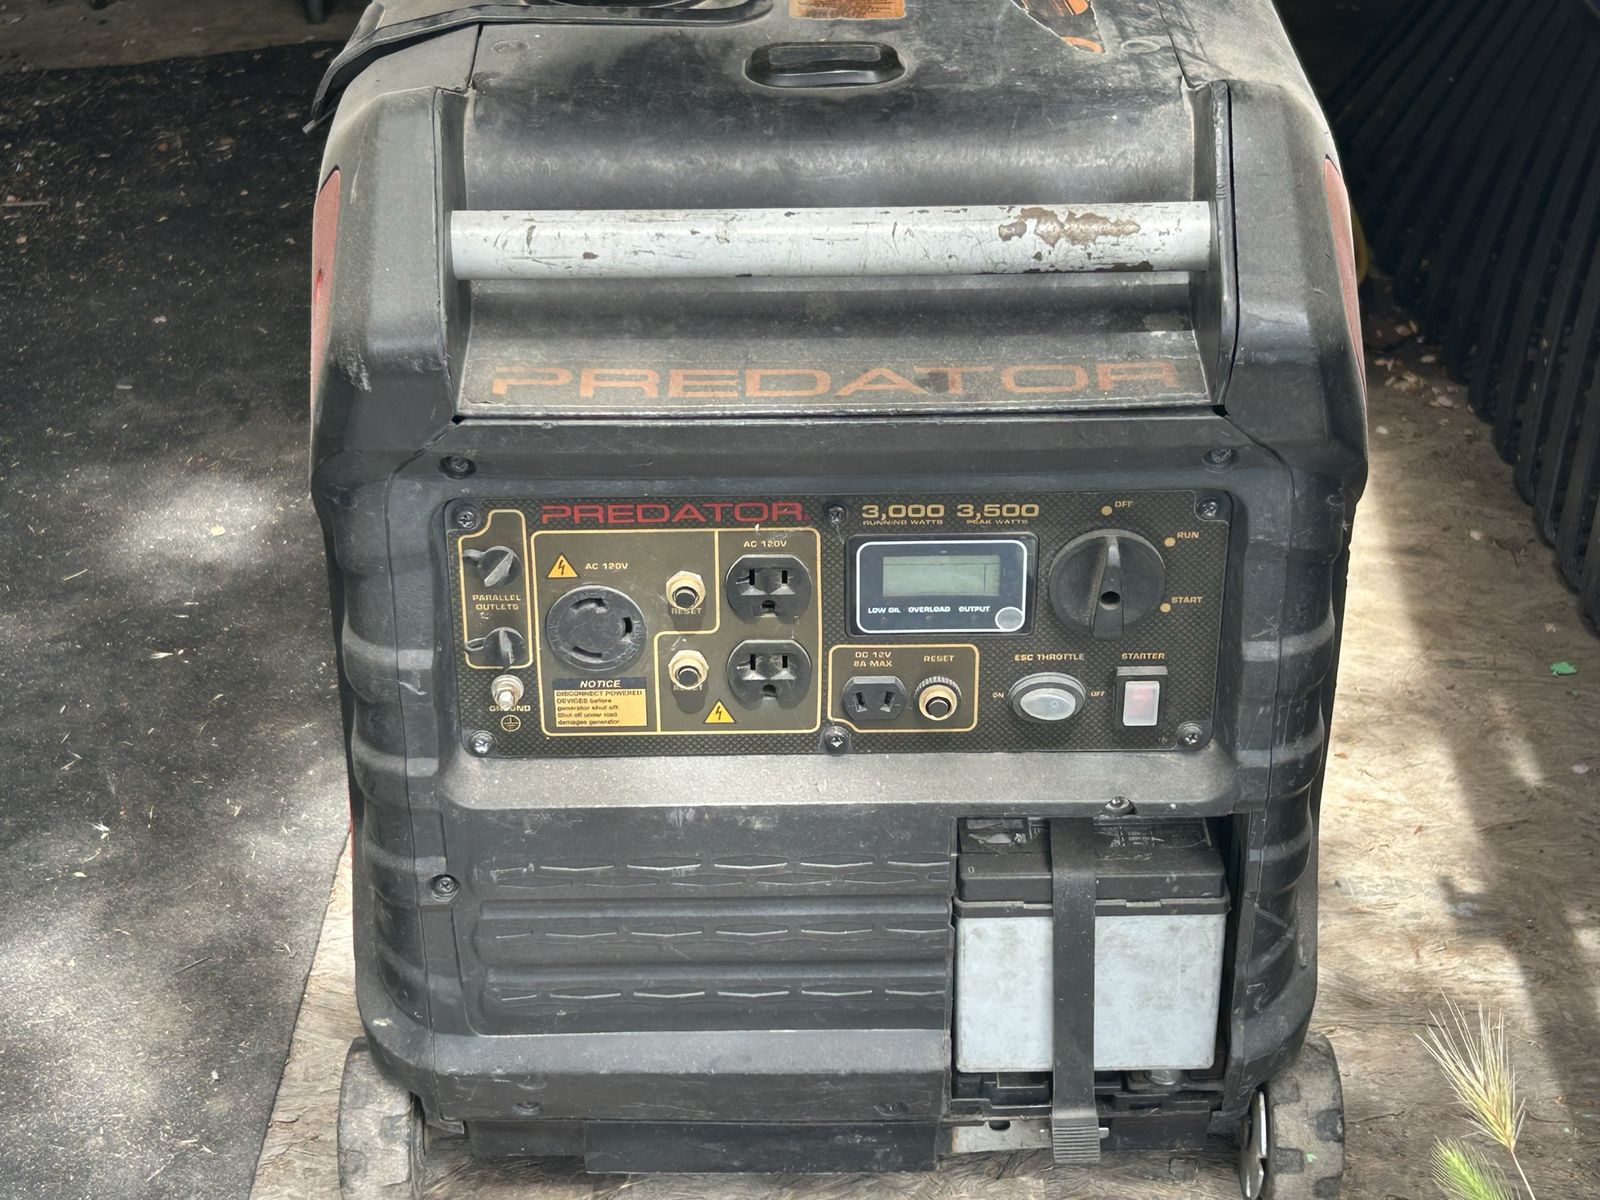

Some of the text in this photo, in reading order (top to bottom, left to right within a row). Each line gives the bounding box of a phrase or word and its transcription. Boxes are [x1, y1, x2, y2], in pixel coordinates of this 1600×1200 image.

[491, 364, 1180, 399] PREDATOR
[1114, 500, 1134, 508] OFF
[541, 502, 802, 524] PREDATOR
[862, 503, 1040, 521] 3,000 3,500
[1176, 531, 1200, 539] RUN
[743, 540, 787, 548] AC 120V
[585, 562, 628, 570] AC 120V
[1171, 596, 1203, 604] START
[475, 603, 519, 611] OUTLETS
[868, 606, 887, 614] LOW
[907, 605, 951, 613] OVERLOAD
[958, 605, 990, 613] OUTPUT
[1014, 653, 1085, 661] ESC THROTTLE
[1121, 652, 1166, 660] STARTER
[580, 679, 622, 688] NOTICE
